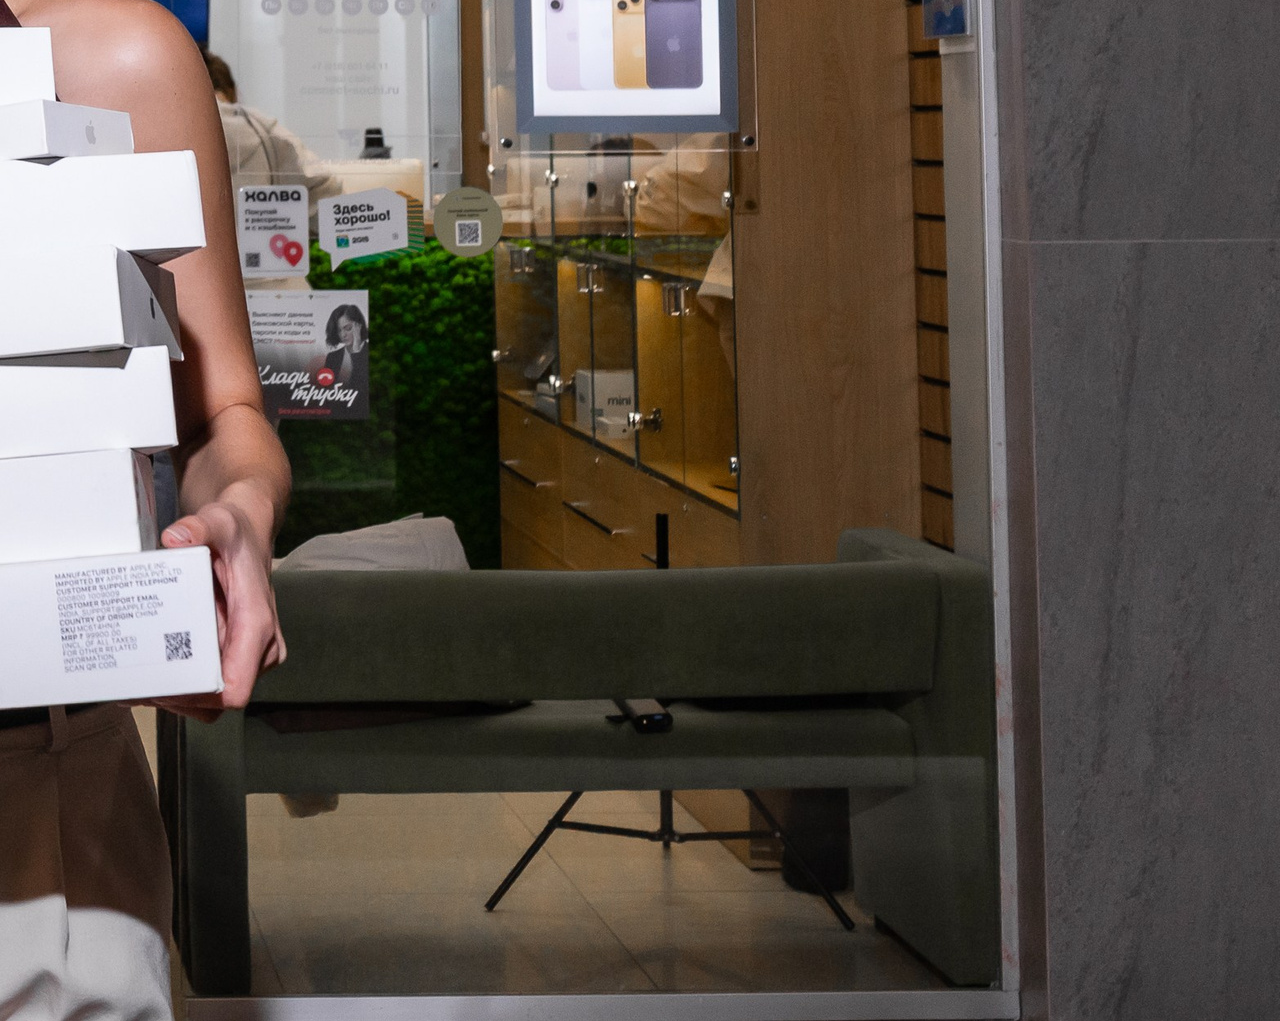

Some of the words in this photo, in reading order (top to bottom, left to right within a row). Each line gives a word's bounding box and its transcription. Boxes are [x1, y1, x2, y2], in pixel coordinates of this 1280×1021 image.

[244, 208, 278, 216] Покупай
[332, 204, 374, 216] Здесь
[334, 210, 391, 227] хорошо!
[258, 365, 310, 390] Клади
[291, 383, 359, 408] трубку
[607, 396, 632, 405] mini
[54, 567, 116, 579] MANUFACTURED
[129, 564, 153, 572] APPLE
[55, 578, 94, 587] IMPORTED
[130, 572, 149, 580] INDIA
[56, 586, 98, 596] CUSTOMER
[99, 582, 134, 591] SUPPORT
[136, 577, 179, 587] TELEPHONE
[57, 602, 99, 611] CUSTOMER
[100, 597, 135, 606] SUPPORT
[137, 594, 159, 602] EMAIL
[59, 617, 95, 626] COUNTRY
[107, 612, 134, 621] ORIGIN
[97, 638, 109, 646] ALL
[78, 647, 104, 655] OTHER
[105, 644, 138, 653] RELATED
[64, 665, 85, 673] SCAN
[98, 660, 118, 670] CODE
